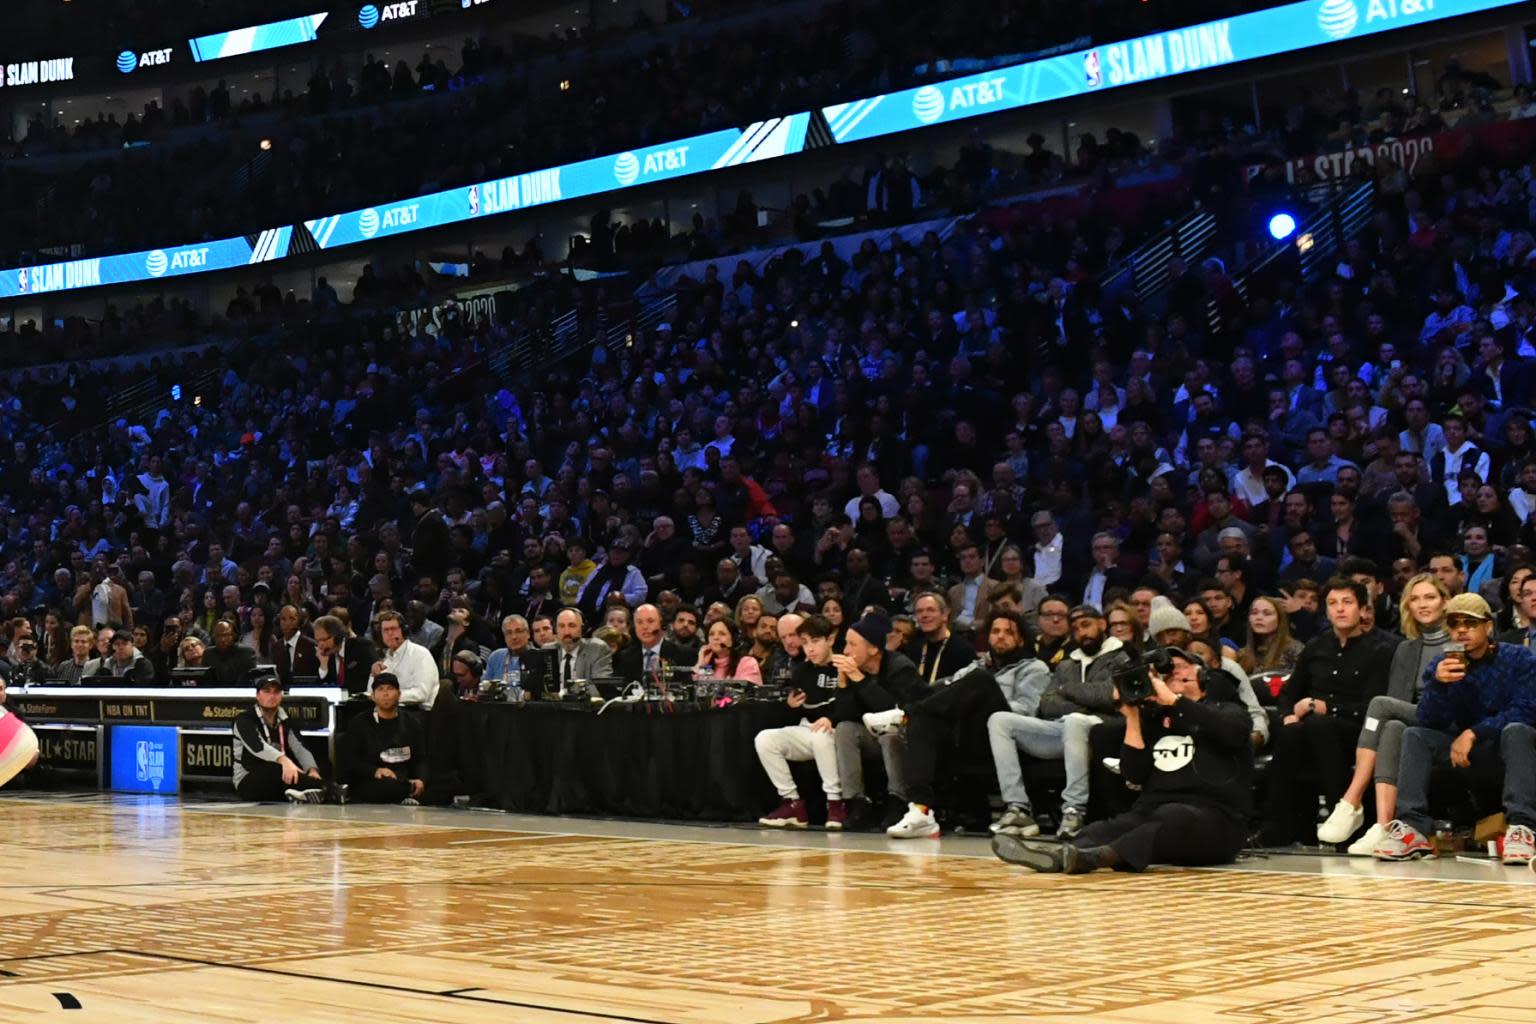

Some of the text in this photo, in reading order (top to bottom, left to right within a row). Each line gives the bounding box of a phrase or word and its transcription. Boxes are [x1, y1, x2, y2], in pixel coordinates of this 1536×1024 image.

[382, 0, 418, 21] AT&T
[140, 49, 173, 68] AT&T
[1108, 22, 1234, 85] SLAM DUNK
[7, 58, 73, 86] SLAM DUNK
[949, 77, 1007, 109] AT&T
[644, 146, 689, 175] AT&T
[484, 169, 561, 214] SLAM DUNK
[382, 204, 419, 229] AT&T
[171, 248, 209, 269] AT&T
[32, 258, 101, 292] SLAM DUNK
[107, 705, 148, 716] NBA ON TNT
[65, 740, 95, 761] STAR
[187, 744, 231, 767] SATUR
